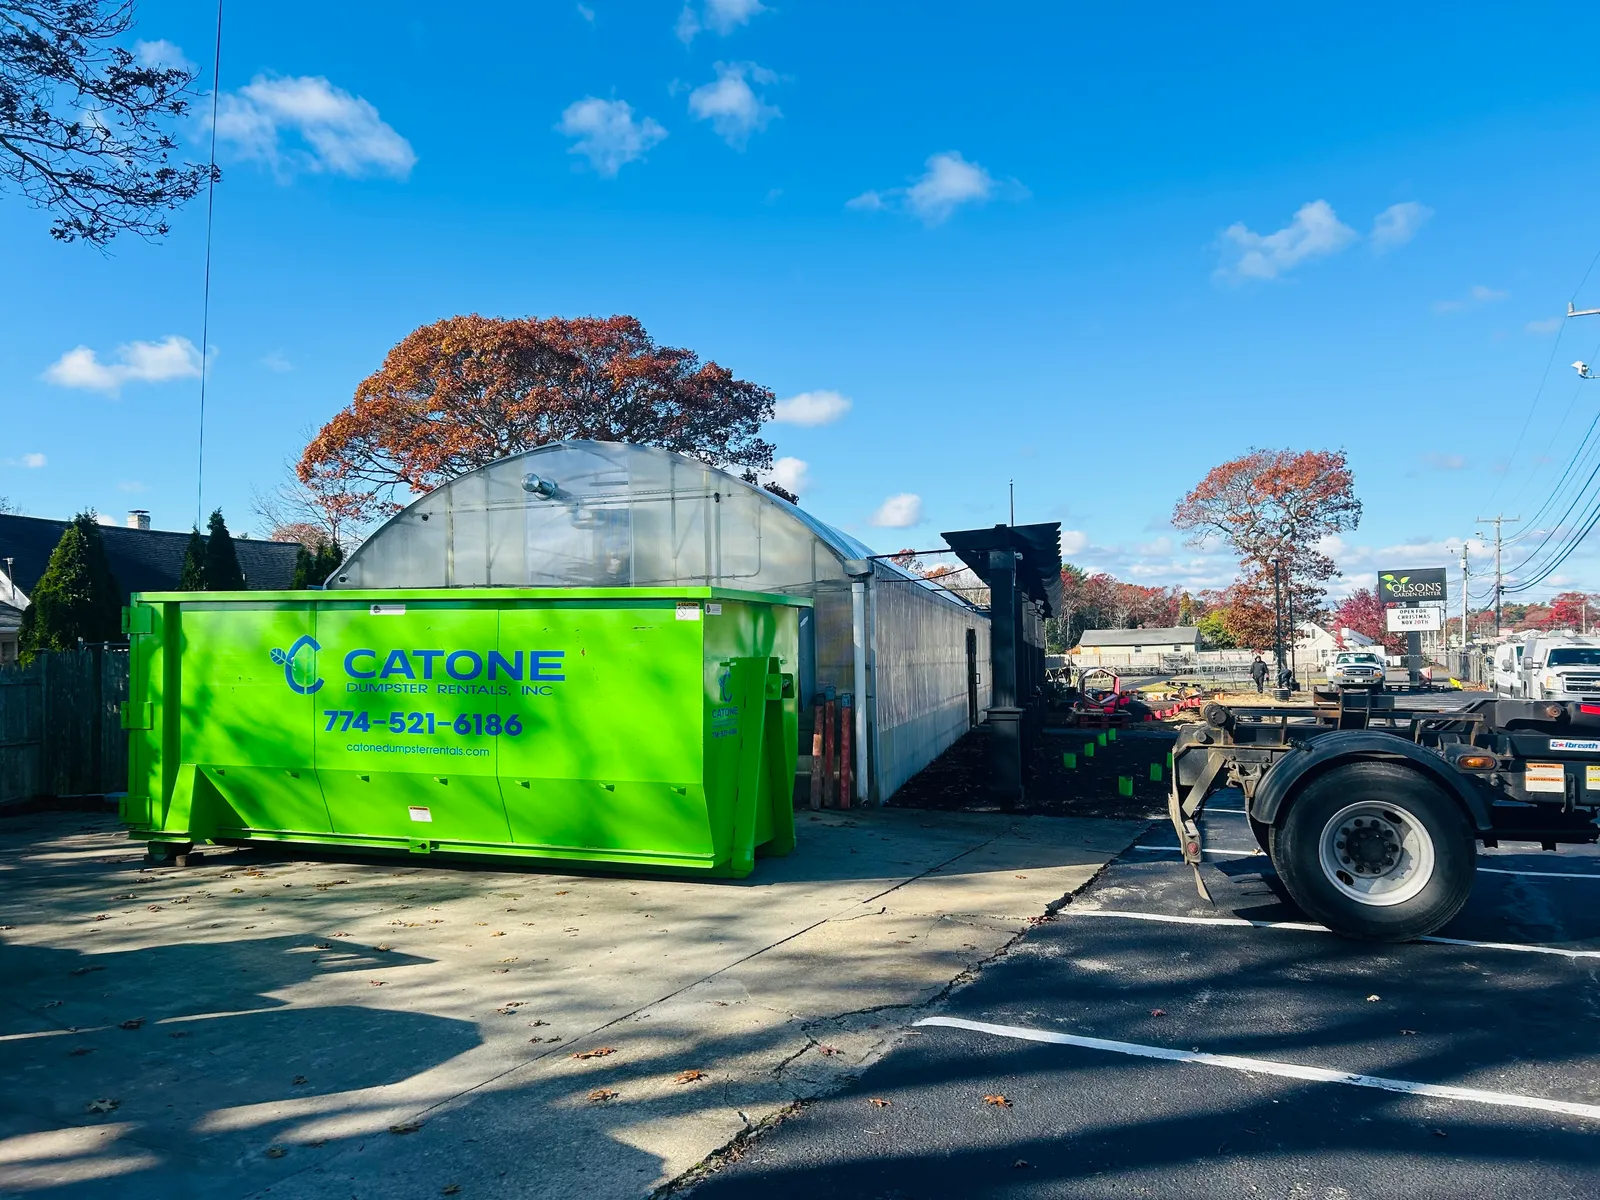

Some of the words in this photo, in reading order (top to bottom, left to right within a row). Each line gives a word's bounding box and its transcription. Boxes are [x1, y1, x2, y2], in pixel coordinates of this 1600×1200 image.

[1392, 583, 1442, 592] OLSON'S
[343, 648, 566, 682] CATONE
[346, 682, 428, 695] DUMPSTER
[437, 684, 512, 696] RENTALS,
[521, 685, 553, 696] INC
[712, 706, 738, 718] CATONE
[323, 710, 524, 737] 774-521-6186
[346, 743, 490, 757] catonedumpsterrentals.com
